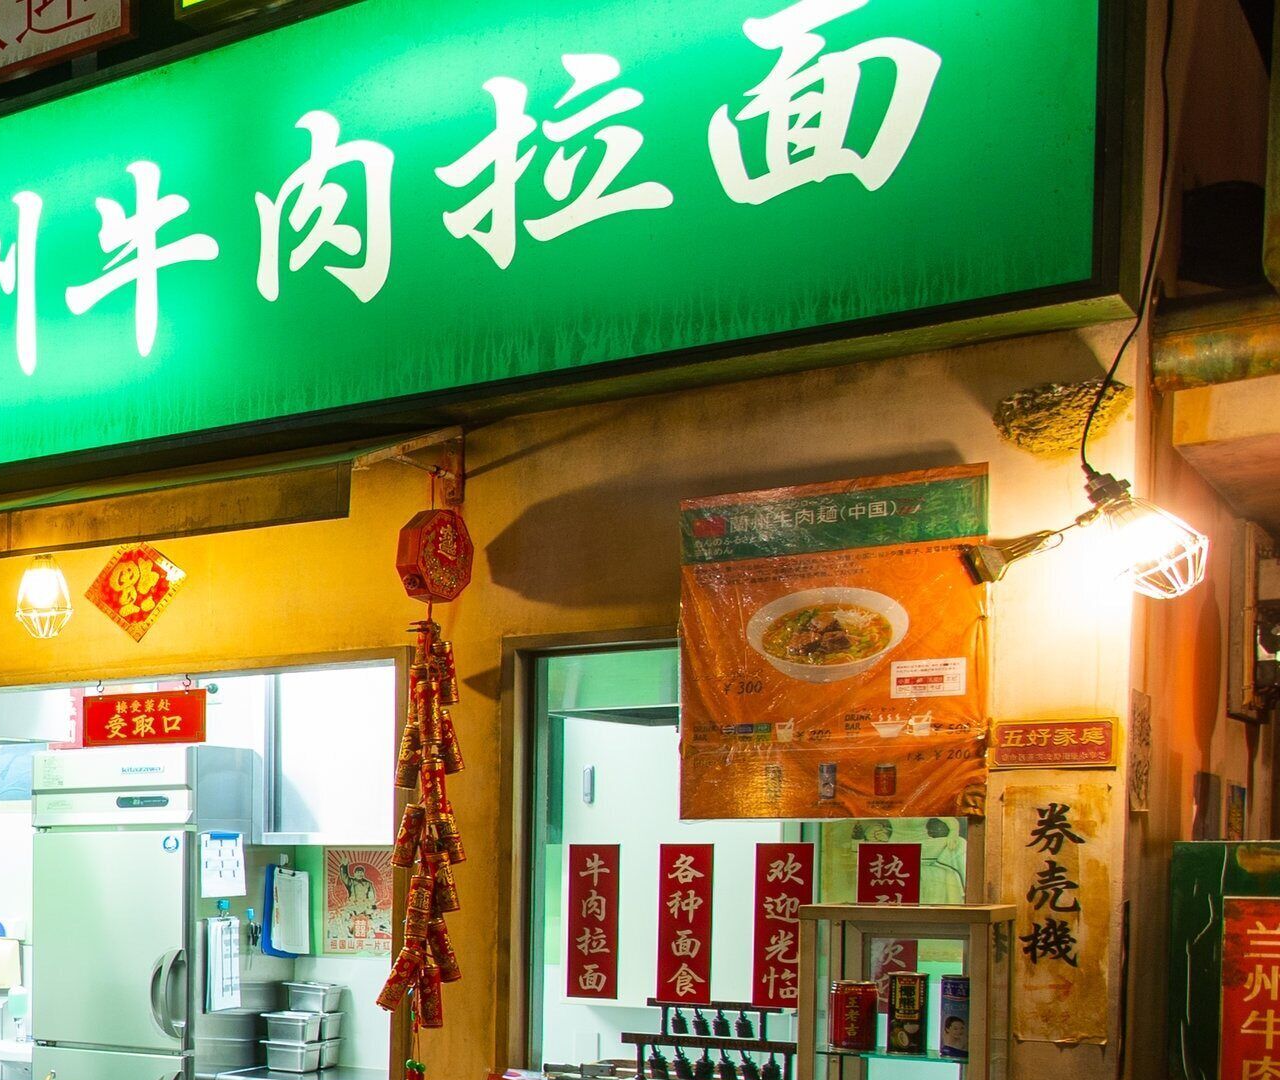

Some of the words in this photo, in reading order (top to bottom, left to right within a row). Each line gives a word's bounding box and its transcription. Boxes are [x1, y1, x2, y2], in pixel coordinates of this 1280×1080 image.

[104, 714, 183, 738] 受取口
[1000, 726, 1107, 748] 五好家庭
[577, 852, 611, 994] 牛肉拉面
[667, 851, 705, 996] 各种面食
[761, 851, 805, 1001] 欢迎光临
[1019, 802, 1086, 968] 券売機
[845, 996, 860, 1037] 王老吉
